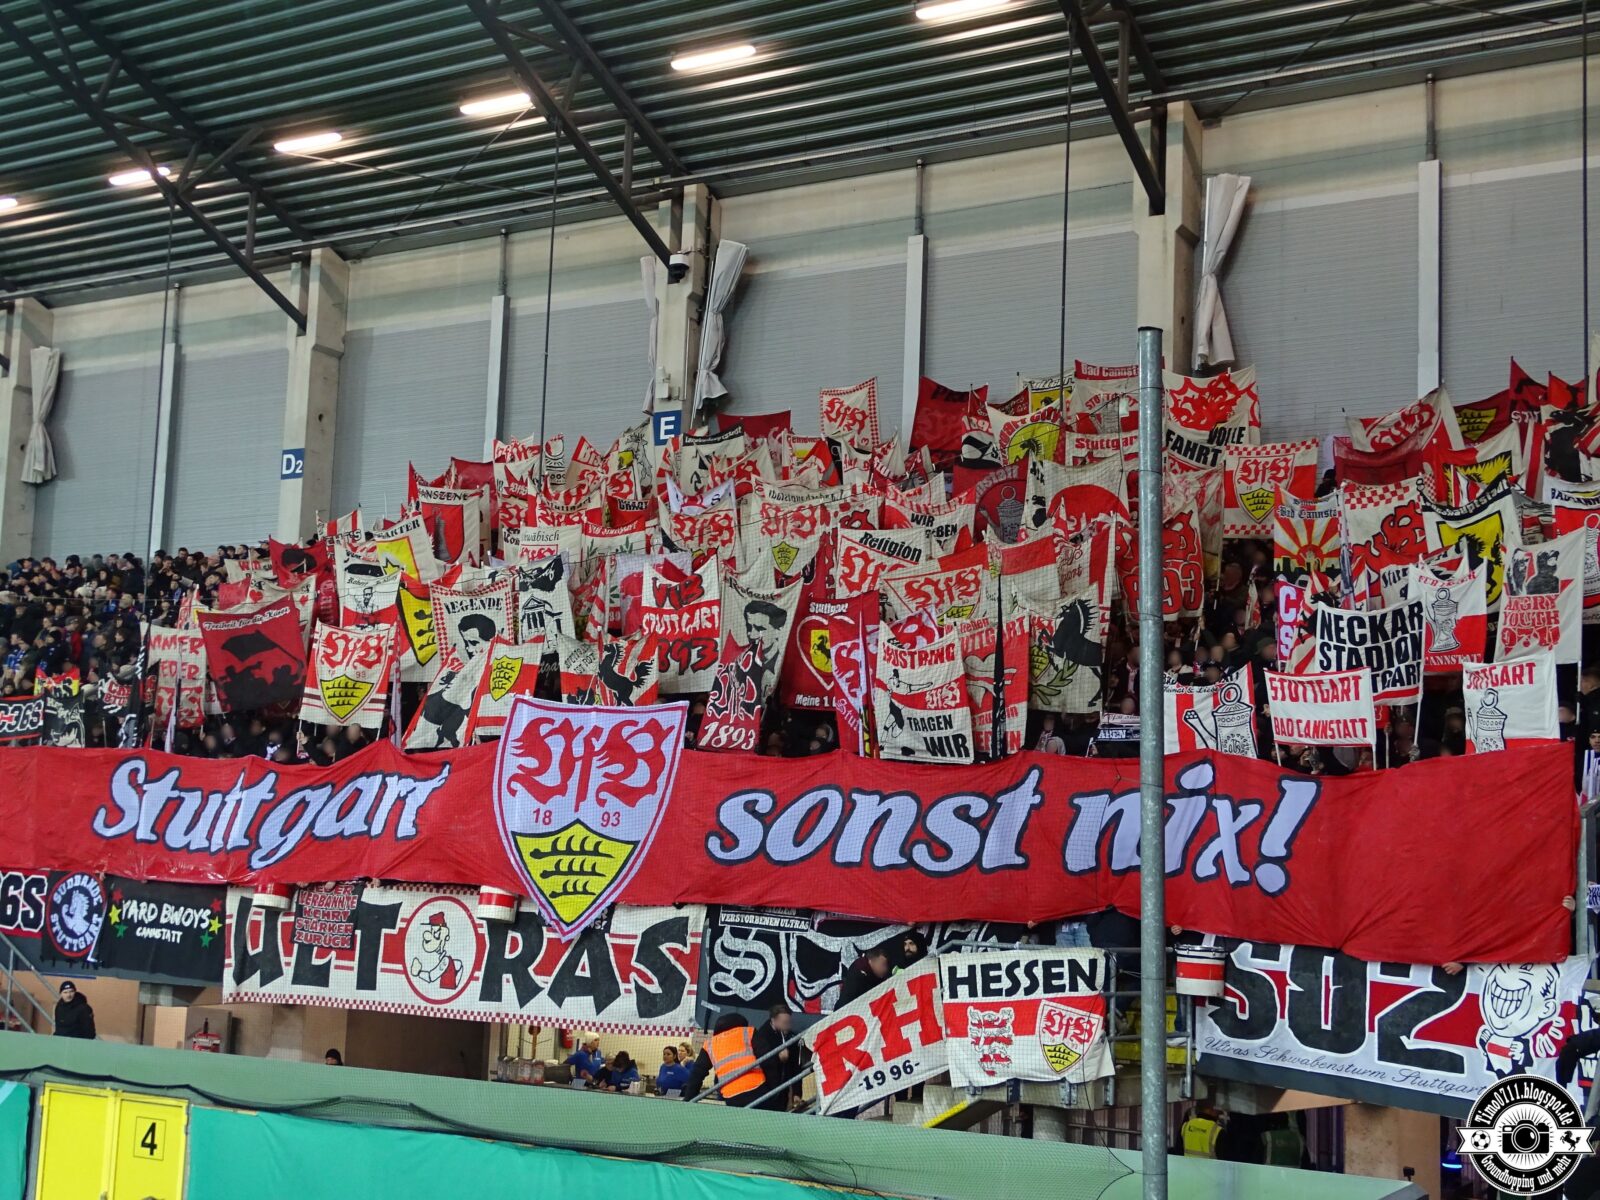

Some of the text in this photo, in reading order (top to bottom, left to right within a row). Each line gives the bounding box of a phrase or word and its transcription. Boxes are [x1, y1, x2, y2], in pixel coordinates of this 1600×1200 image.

[660, 417, 675, 440] E
[1165, 427, 1246, 467] VOLLE FAHRT
[282, 455, 303, 475] D2
[911, 512, 935, 526] WIR
[858, 531, 922, 563] Religion
[444, 598, 504, 615] LEGENDE
[809, 602, 849, 617] Stuttgart
[1505, 595, 1560, 611] ANGRY
[642, 605, 720, 635] STUTTGART
[1320, 601, 1424, 646] NECKAR
[1504, 610, 1560, 625] YOUTH
[149, 632, 206, 656] MMER
[1319, 632, 1423, 673] STADION
[795, 694, 820, 706] Meine
[1268, 675, 1363, 706] STUTTGART
[906, 714, 954, 732] TRAGEN
[1273, 717, 1365, 744] BAD CANNSTATT
[699, 721, 757, 750] 1893
[924, 733, 971, 758] WIR
[92, 756, 1321, 897] Stuttgart sonst nix!
[532, 808, 621, 827] 18 93
[298, 891, 358, 909] VERBANNTE
[121, 899, 212, 929] YARD BWOYS
[302, 907, 351, 921] KEHRT
[720, 913, 810, 931] VERSTORBENEN ULTRAS
[136, 926, 183, 944] CANNSTATT
[948, 958, 1098, 1000] HESSEN
[812, 972, 944, 1097] RH
[1204, 1036, 1487, 1097] Ultras Schwabensturm Stuttgart
[140, 1122, 158, 1156] 4
